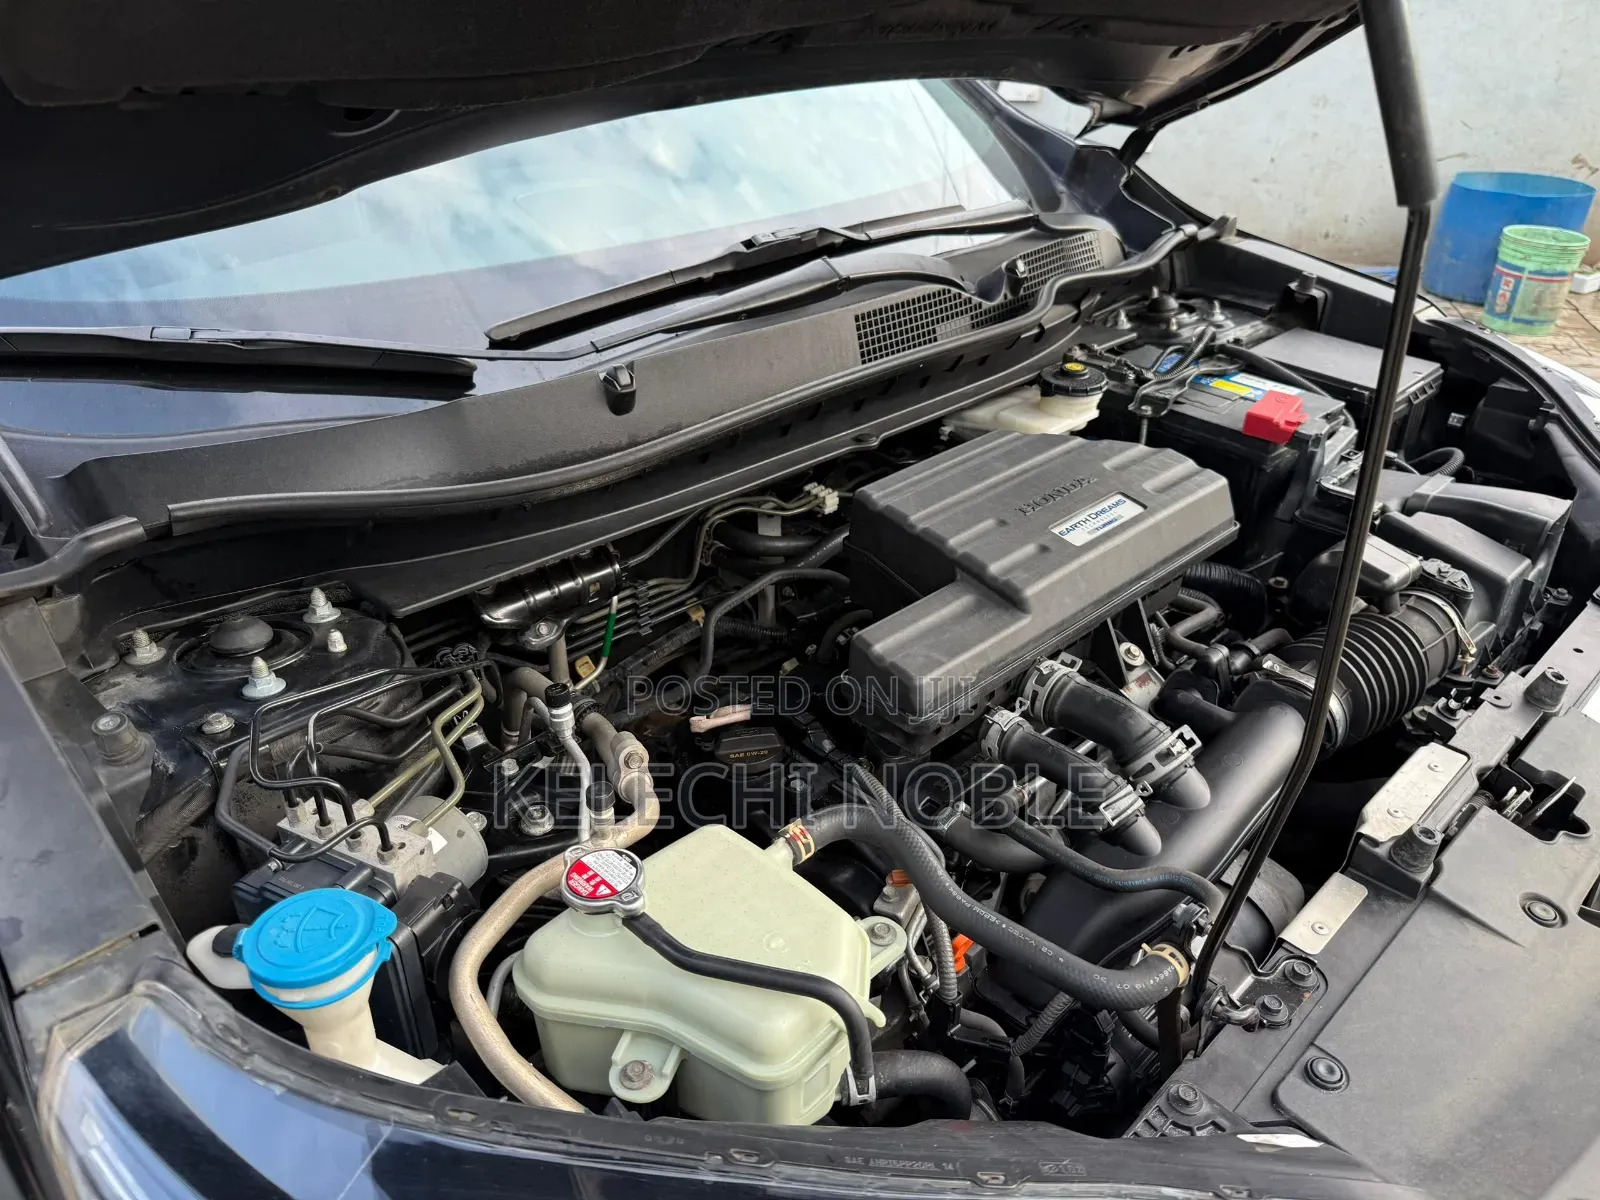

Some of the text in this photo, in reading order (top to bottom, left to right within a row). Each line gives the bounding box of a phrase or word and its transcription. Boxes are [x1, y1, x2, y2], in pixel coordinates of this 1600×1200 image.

[1014, 477, 1098, 516] HONDA
[1058, 498, 1127, 537] EARTH DREAMS
